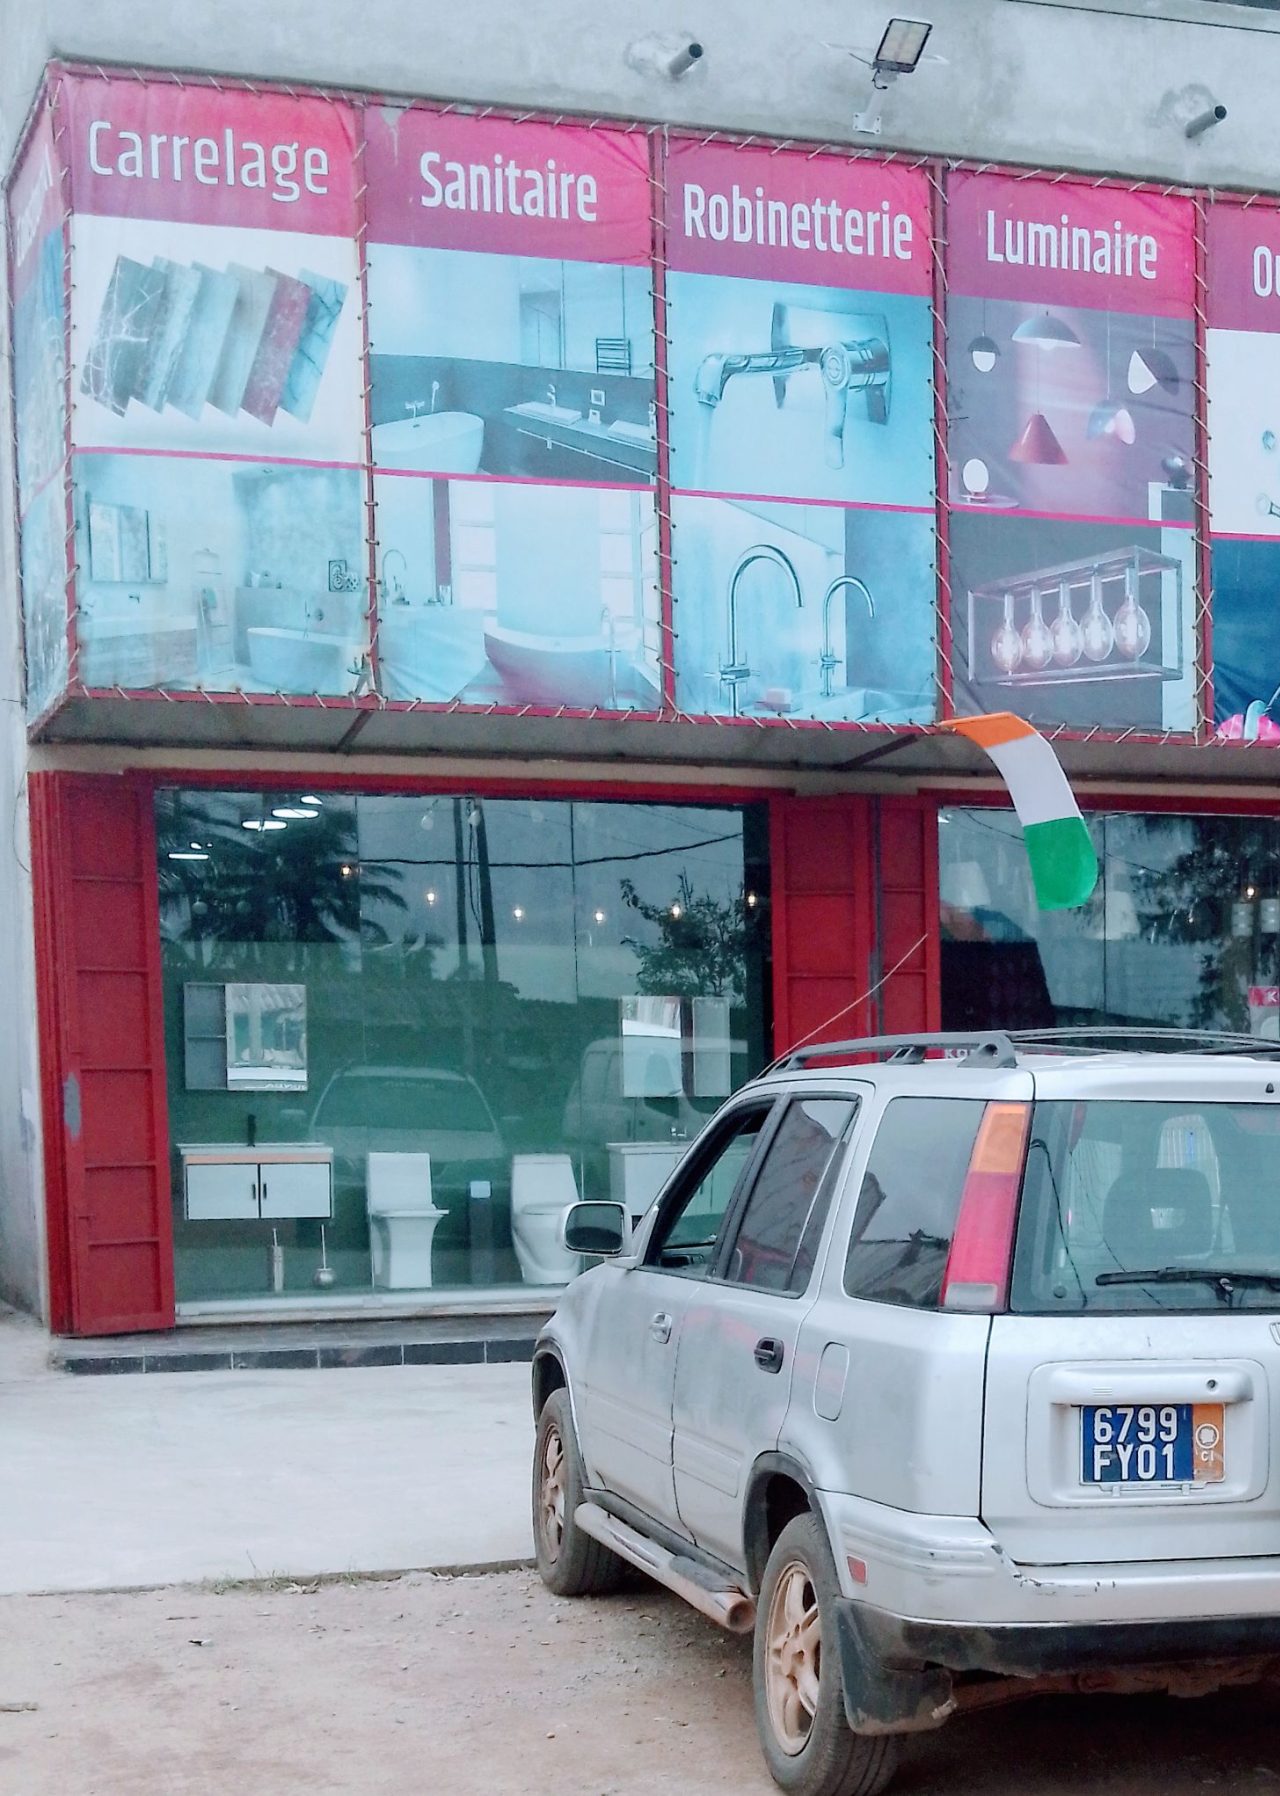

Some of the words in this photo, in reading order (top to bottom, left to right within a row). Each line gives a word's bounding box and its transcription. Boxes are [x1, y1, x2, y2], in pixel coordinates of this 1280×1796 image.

[89, 121, 329, 202] Carrelage
[420, 151, 598, 222] Sanitaire
[684, 183, 913, 260] Robinetterie
[986, 209, 1158, 280] Luminaire
[1093, 1406, 1178, 1443] 6799
[1093, 1443, 1175, 1481] FY01
